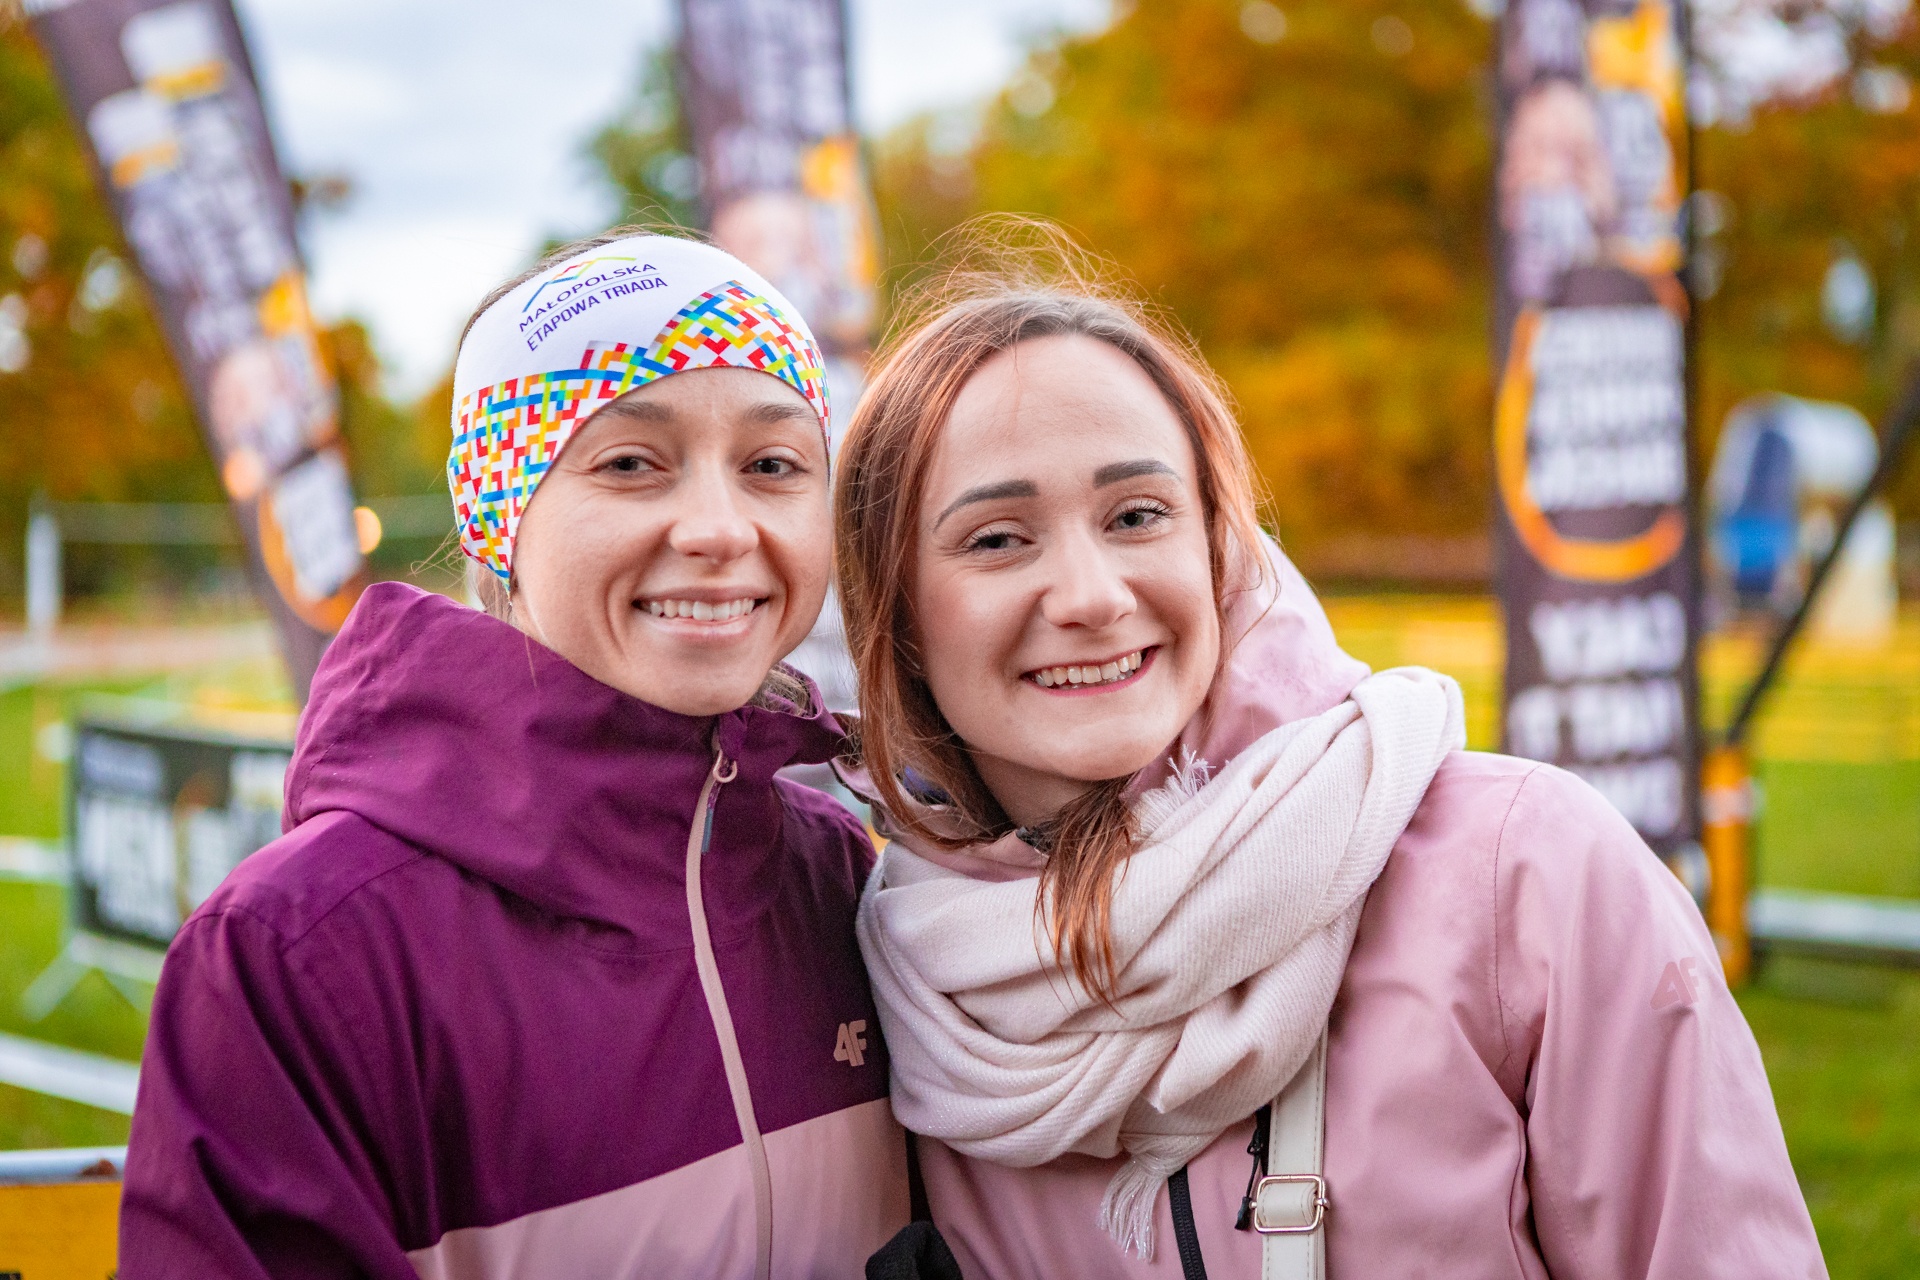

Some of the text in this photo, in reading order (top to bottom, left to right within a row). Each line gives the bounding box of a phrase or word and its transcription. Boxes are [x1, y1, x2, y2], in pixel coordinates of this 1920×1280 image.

[519, 263, 657, 333] MAŁOPOLSKA
[526, 277, 668, 352] ETAPOWA TRIADA
[1649, 957, 1699, 1010] 4F
[833, 1019, 867, 1067] 4F
